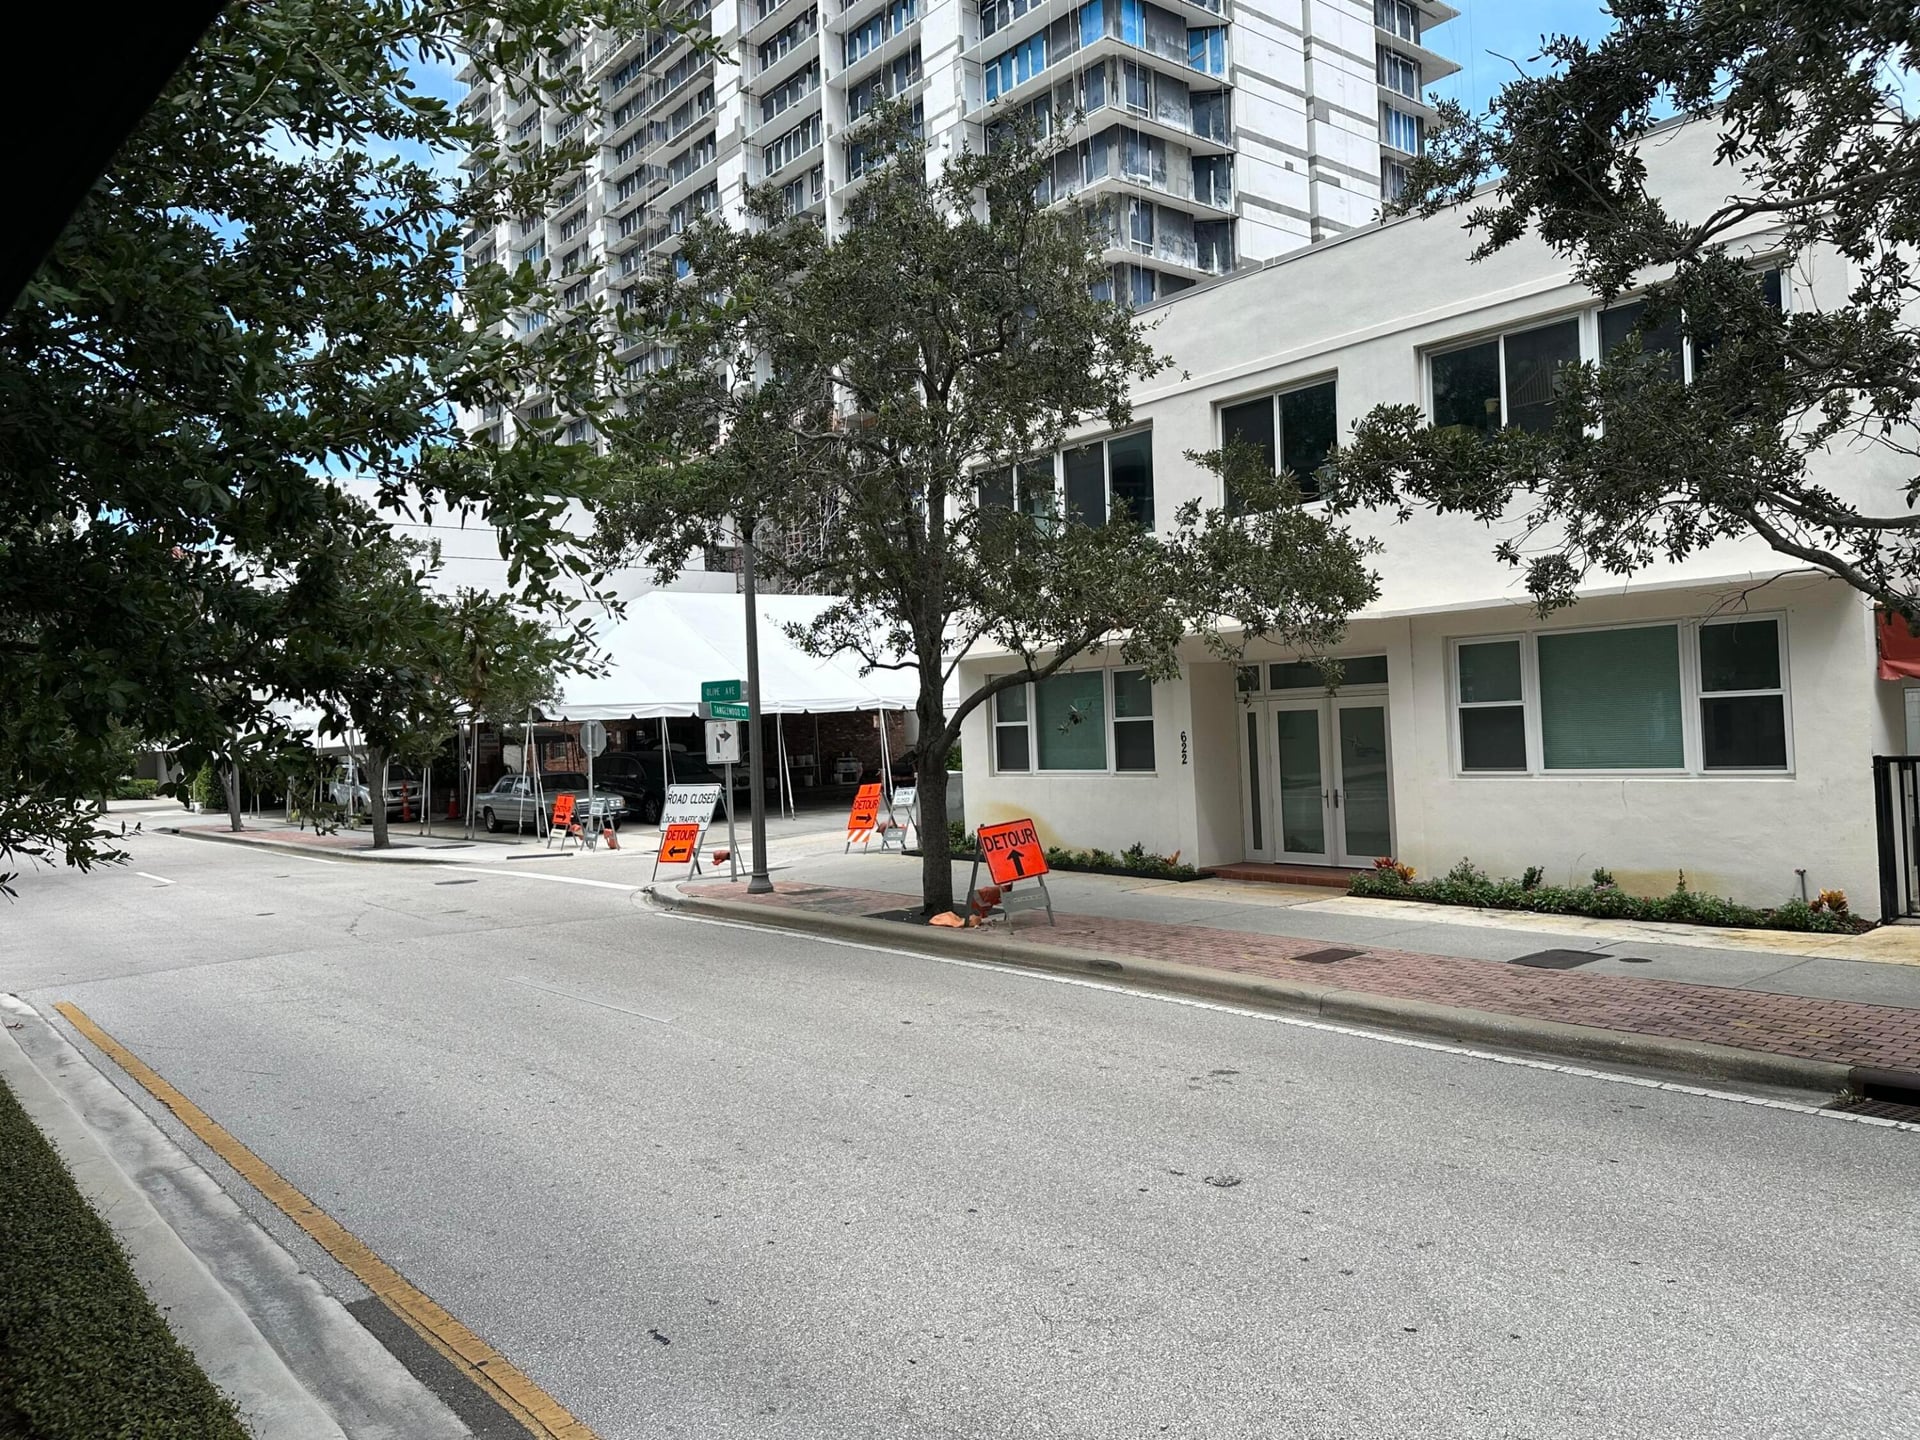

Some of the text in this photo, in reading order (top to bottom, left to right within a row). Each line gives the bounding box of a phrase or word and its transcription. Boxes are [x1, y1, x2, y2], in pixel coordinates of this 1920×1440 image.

[724, 685, 736, 695] AVE
[713, 704, 740, 717] TANGLEWOOD
[1180, 730, 1188, 765] 622
[667, 793, 717, 804] ROAD CLOSED
[854, 799, 878, 810] DETOUR
[663, 815, 677, 823] LOCAL
[679, 815, 698, 823] TRAFFIC
[667, 830, 696, 840] DETOUR
[983, 828, 1036, 852] DETOUR
